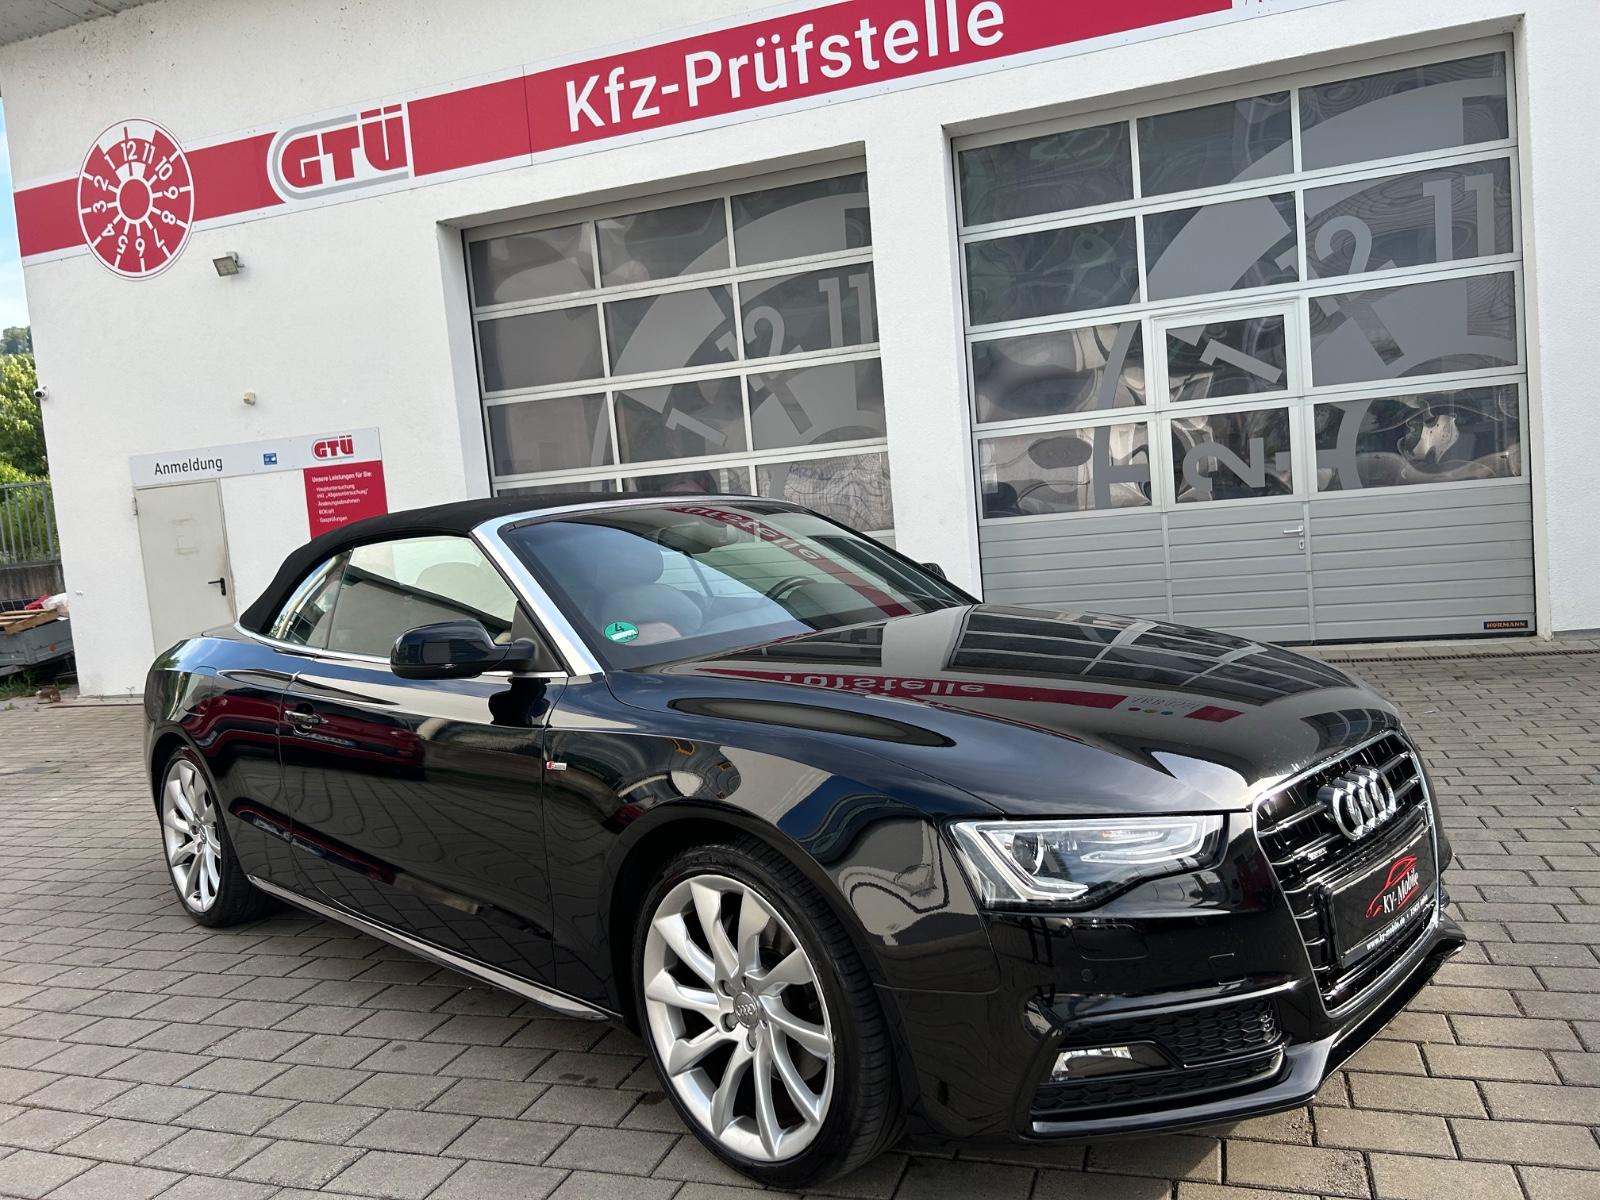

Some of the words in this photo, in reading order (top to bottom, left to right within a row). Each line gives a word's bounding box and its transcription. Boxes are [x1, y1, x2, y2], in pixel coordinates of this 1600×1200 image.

[565, 0, 1004, 132] Kfz-Prüfstelle
[121, 141, 137, 161] 12
[142, 142, 155, 164] 11
[281, 103, 408, 189] GTÜ
[104, 154, 116, 170] 1
[155, 156, 173, 180] 10
[94, 175, 109, 191] 2
[164, 186, 179, 199] 9
[92, 200, 107, 214] 3
[161, 210, 176, 225] 8
[102, 223, 115, 237] 4
[154, 228, 165, 248] 7
[117, 236, 128, 254] 5
[135, 238, 145, 257] 6
[314, 435, 354, 458] GTÜ
[154, 457, 223, 476] Anmeldung
[329, 472, 355, 481] Leistungen
